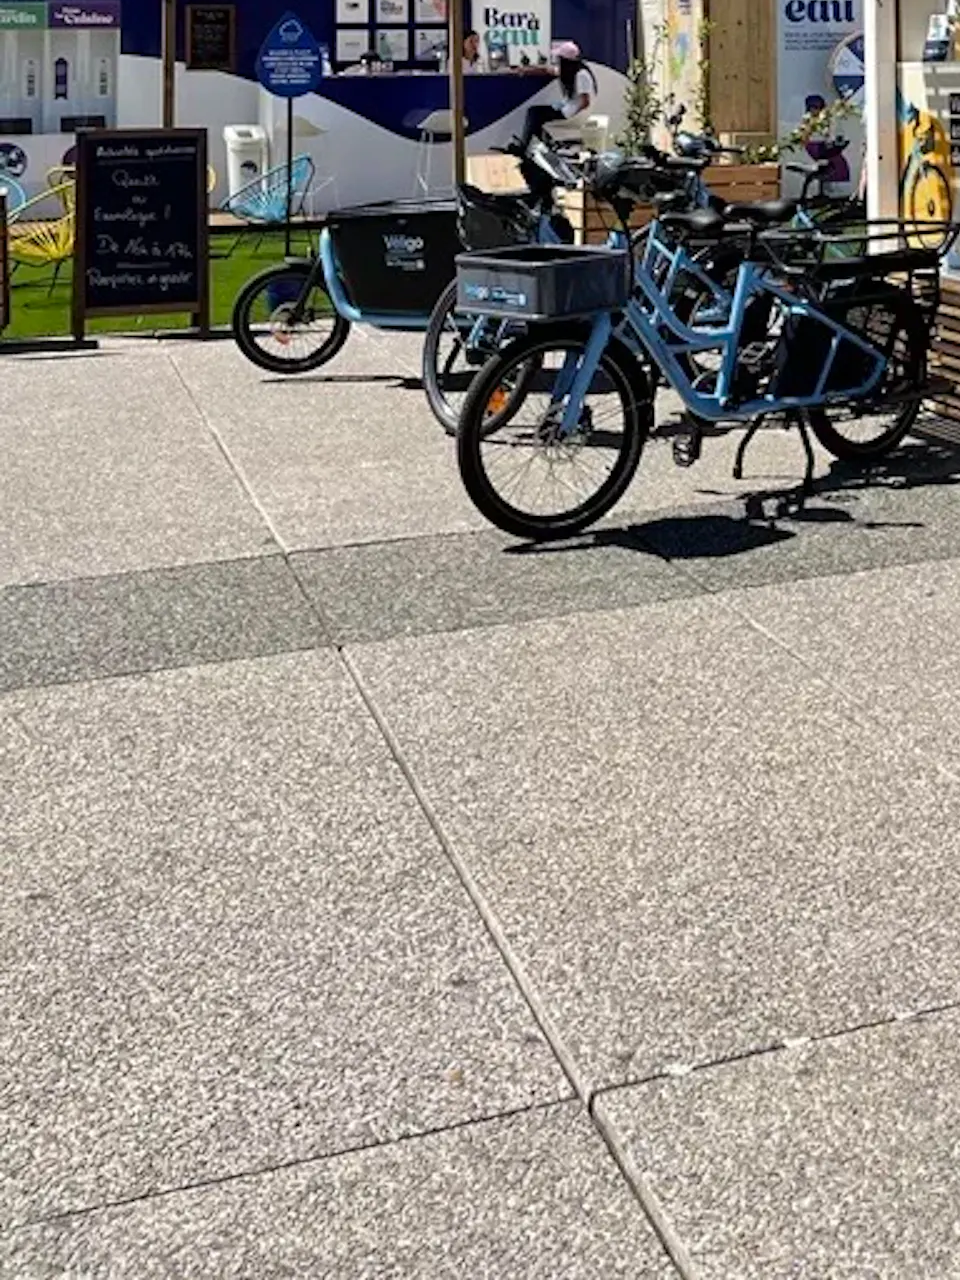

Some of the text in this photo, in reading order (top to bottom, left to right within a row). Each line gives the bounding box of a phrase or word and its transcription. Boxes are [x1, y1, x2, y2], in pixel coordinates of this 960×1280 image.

[484, 7, 540, 30] Bar à
[785, 0, 855, 22] eau
[484, 28, 539, 46] eau
